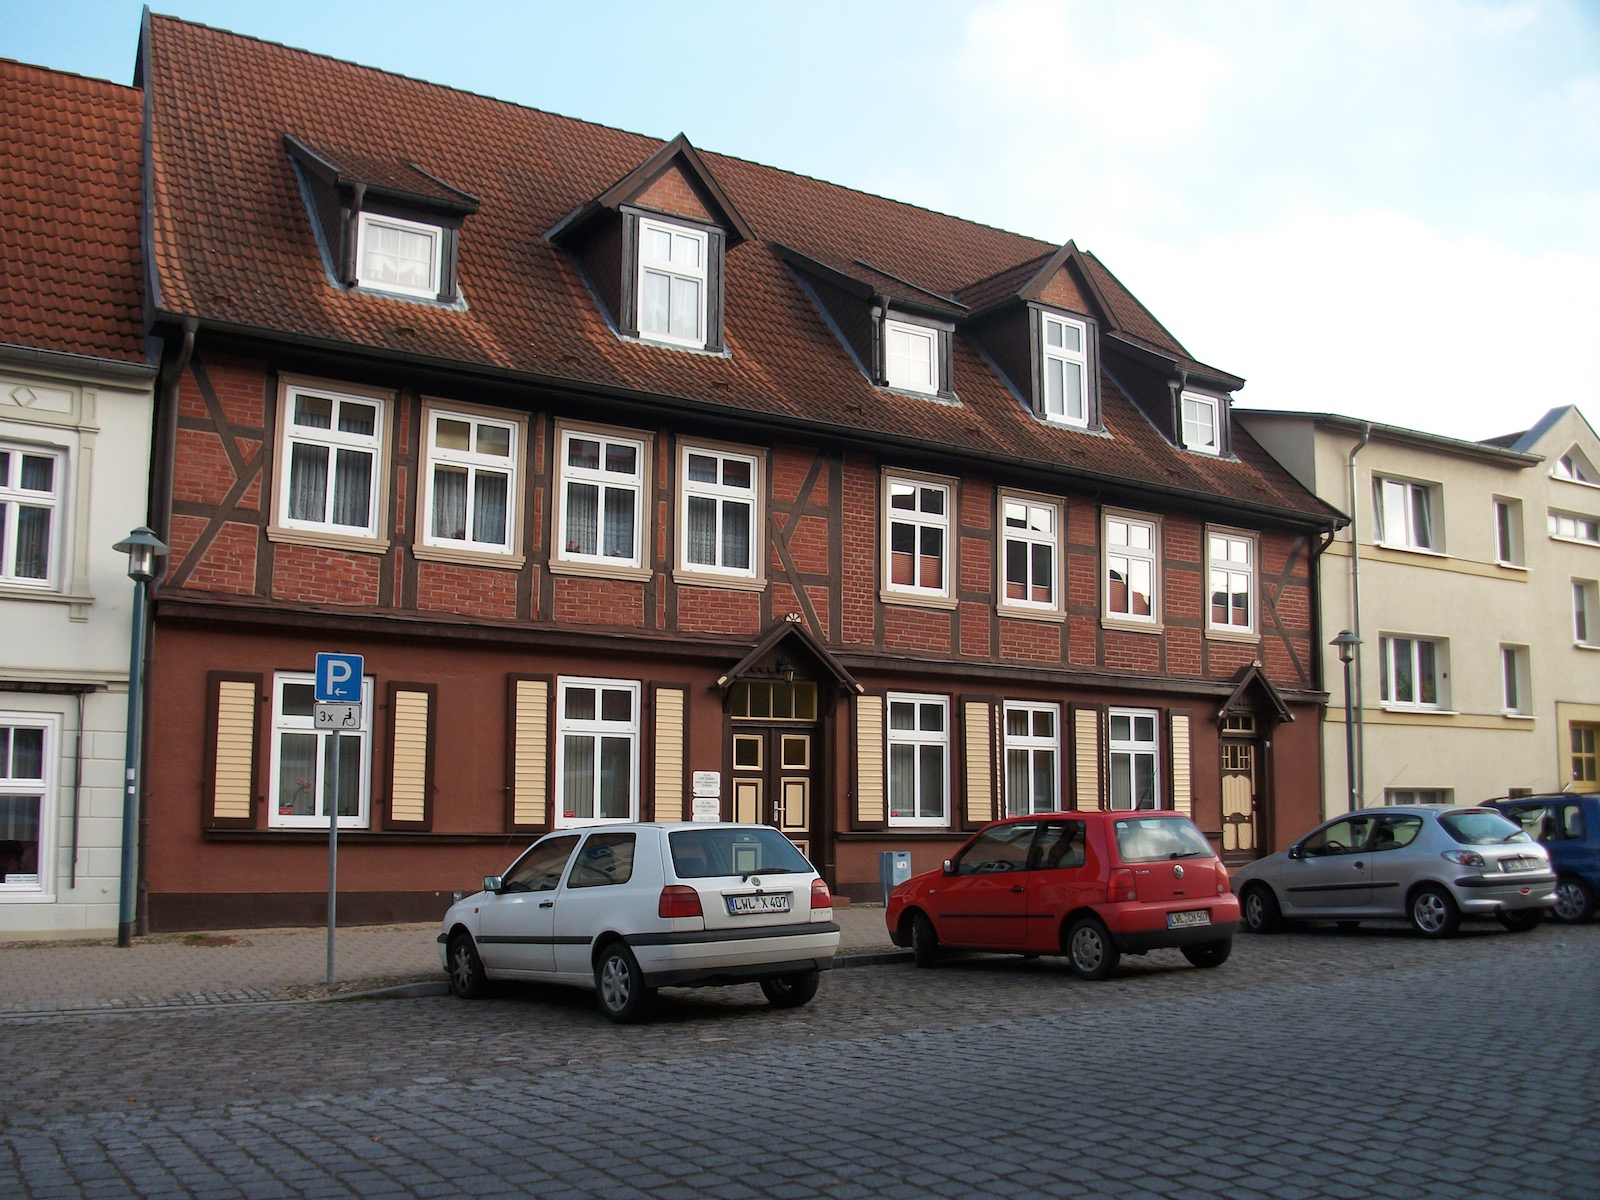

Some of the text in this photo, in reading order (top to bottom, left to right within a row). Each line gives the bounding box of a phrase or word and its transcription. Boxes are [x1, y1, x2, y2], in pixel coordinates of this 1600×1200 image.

[326, 660, 352, 695] P
[319, 710, 334, 722] 3x
[734, 898, 756, 910] LWL
[761, 897, 769, 909] X
